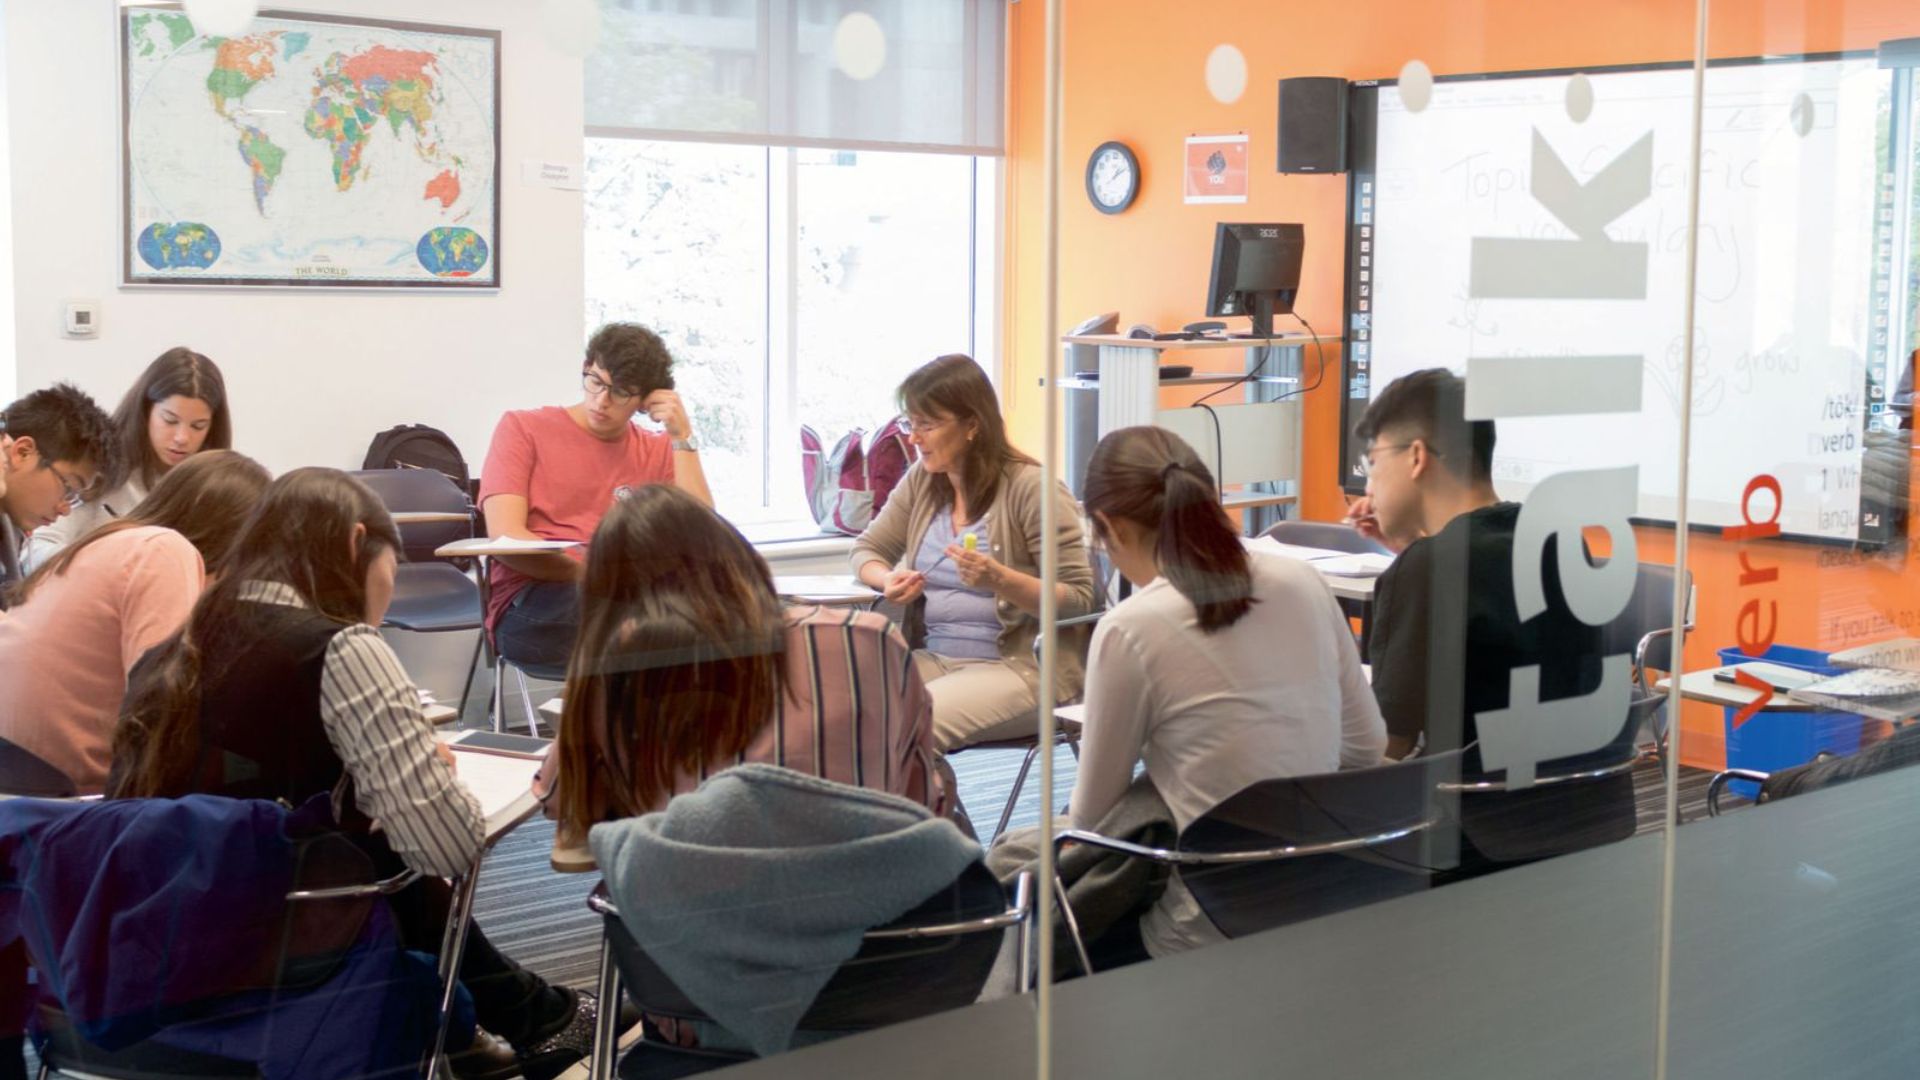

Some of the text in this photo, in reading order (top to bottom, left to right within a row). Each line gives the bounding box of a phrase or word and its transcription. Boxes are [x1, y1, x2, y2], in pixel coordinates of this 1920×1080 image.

[1440, 150, 1530, 222] Topi
[315, 266, 349, 276] WORLD
[1821, 427, 1855, 453] verb
[1463, 126, 1654, 790] talk
[1818, 505, 1858, 534] langu
[1722, 474, 1783, 730] verb
[1842, 617, 1870, 647] you
